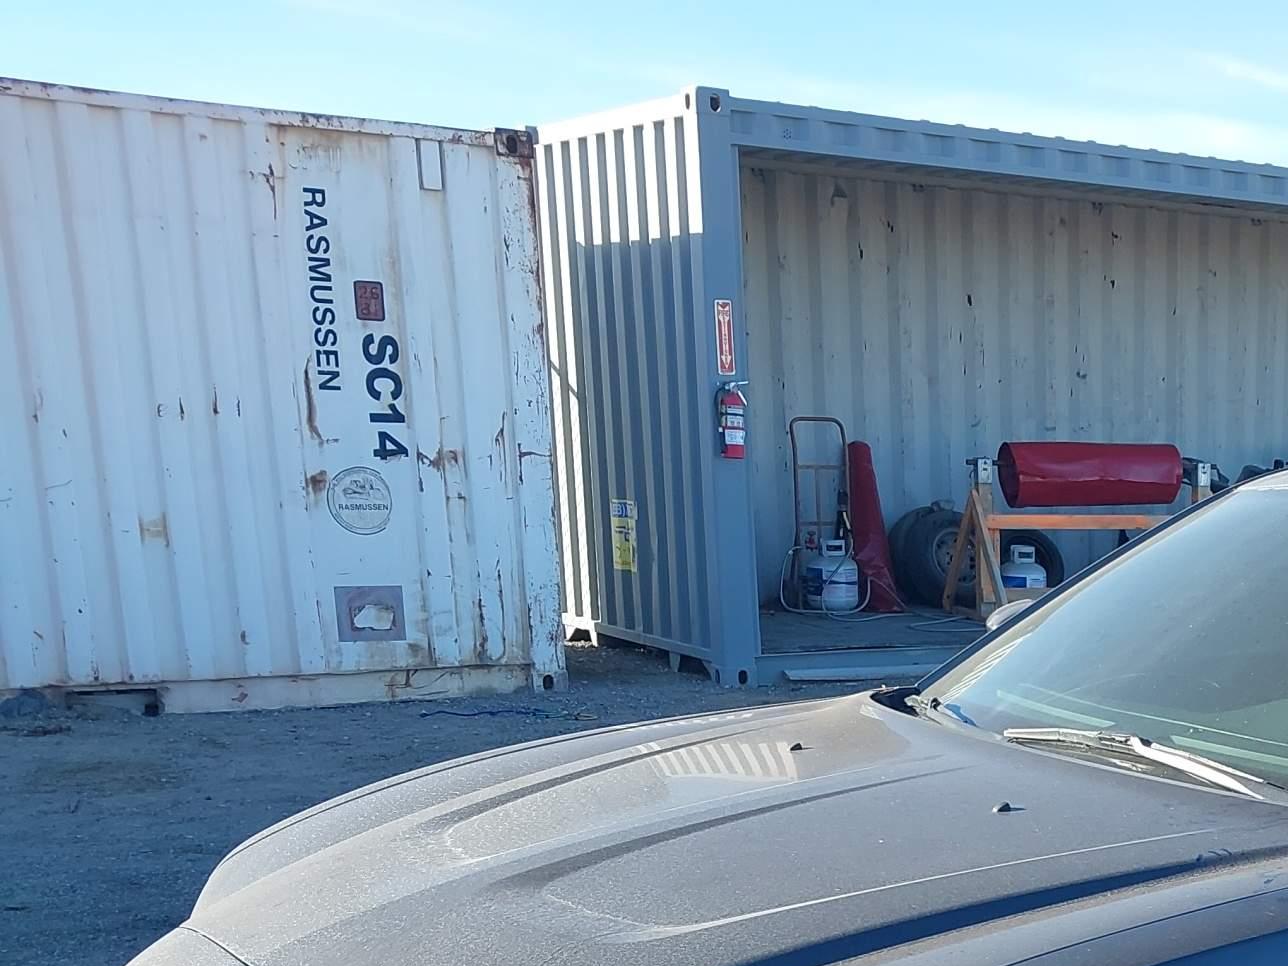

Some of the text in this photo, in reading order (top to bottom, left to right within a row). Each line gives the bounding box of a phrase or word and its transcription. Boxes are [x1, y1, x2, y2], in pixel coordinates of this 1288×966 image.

[303, 187, 341, 391] RASMUSSEN
[362, 333, 409, 461] SC14
[338, 503, 389, 511] RASMUSSEN
